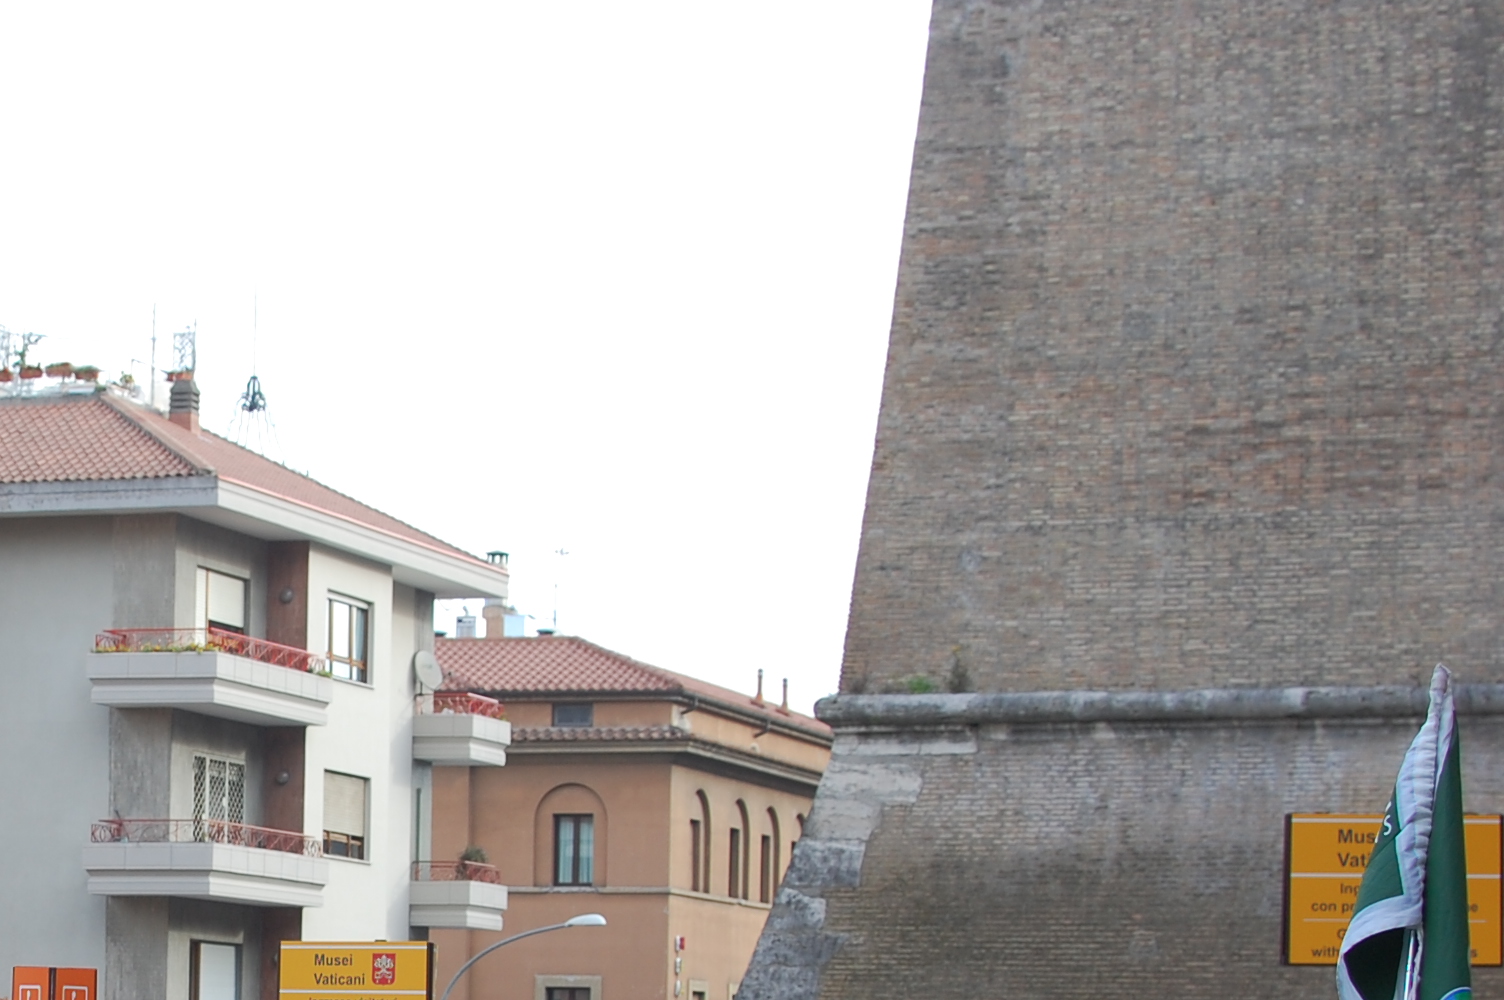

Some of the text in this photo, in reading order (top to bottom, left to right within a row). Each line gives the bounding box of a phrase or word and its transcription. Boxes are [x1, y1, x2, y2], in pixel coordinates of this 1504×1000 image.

[1337, 829, 1375, 844] Mus
[1311, 902, 1337, 912] con
[314, 953, 353, 966] Musei
[314, 973, 365, 985] Vaticani
